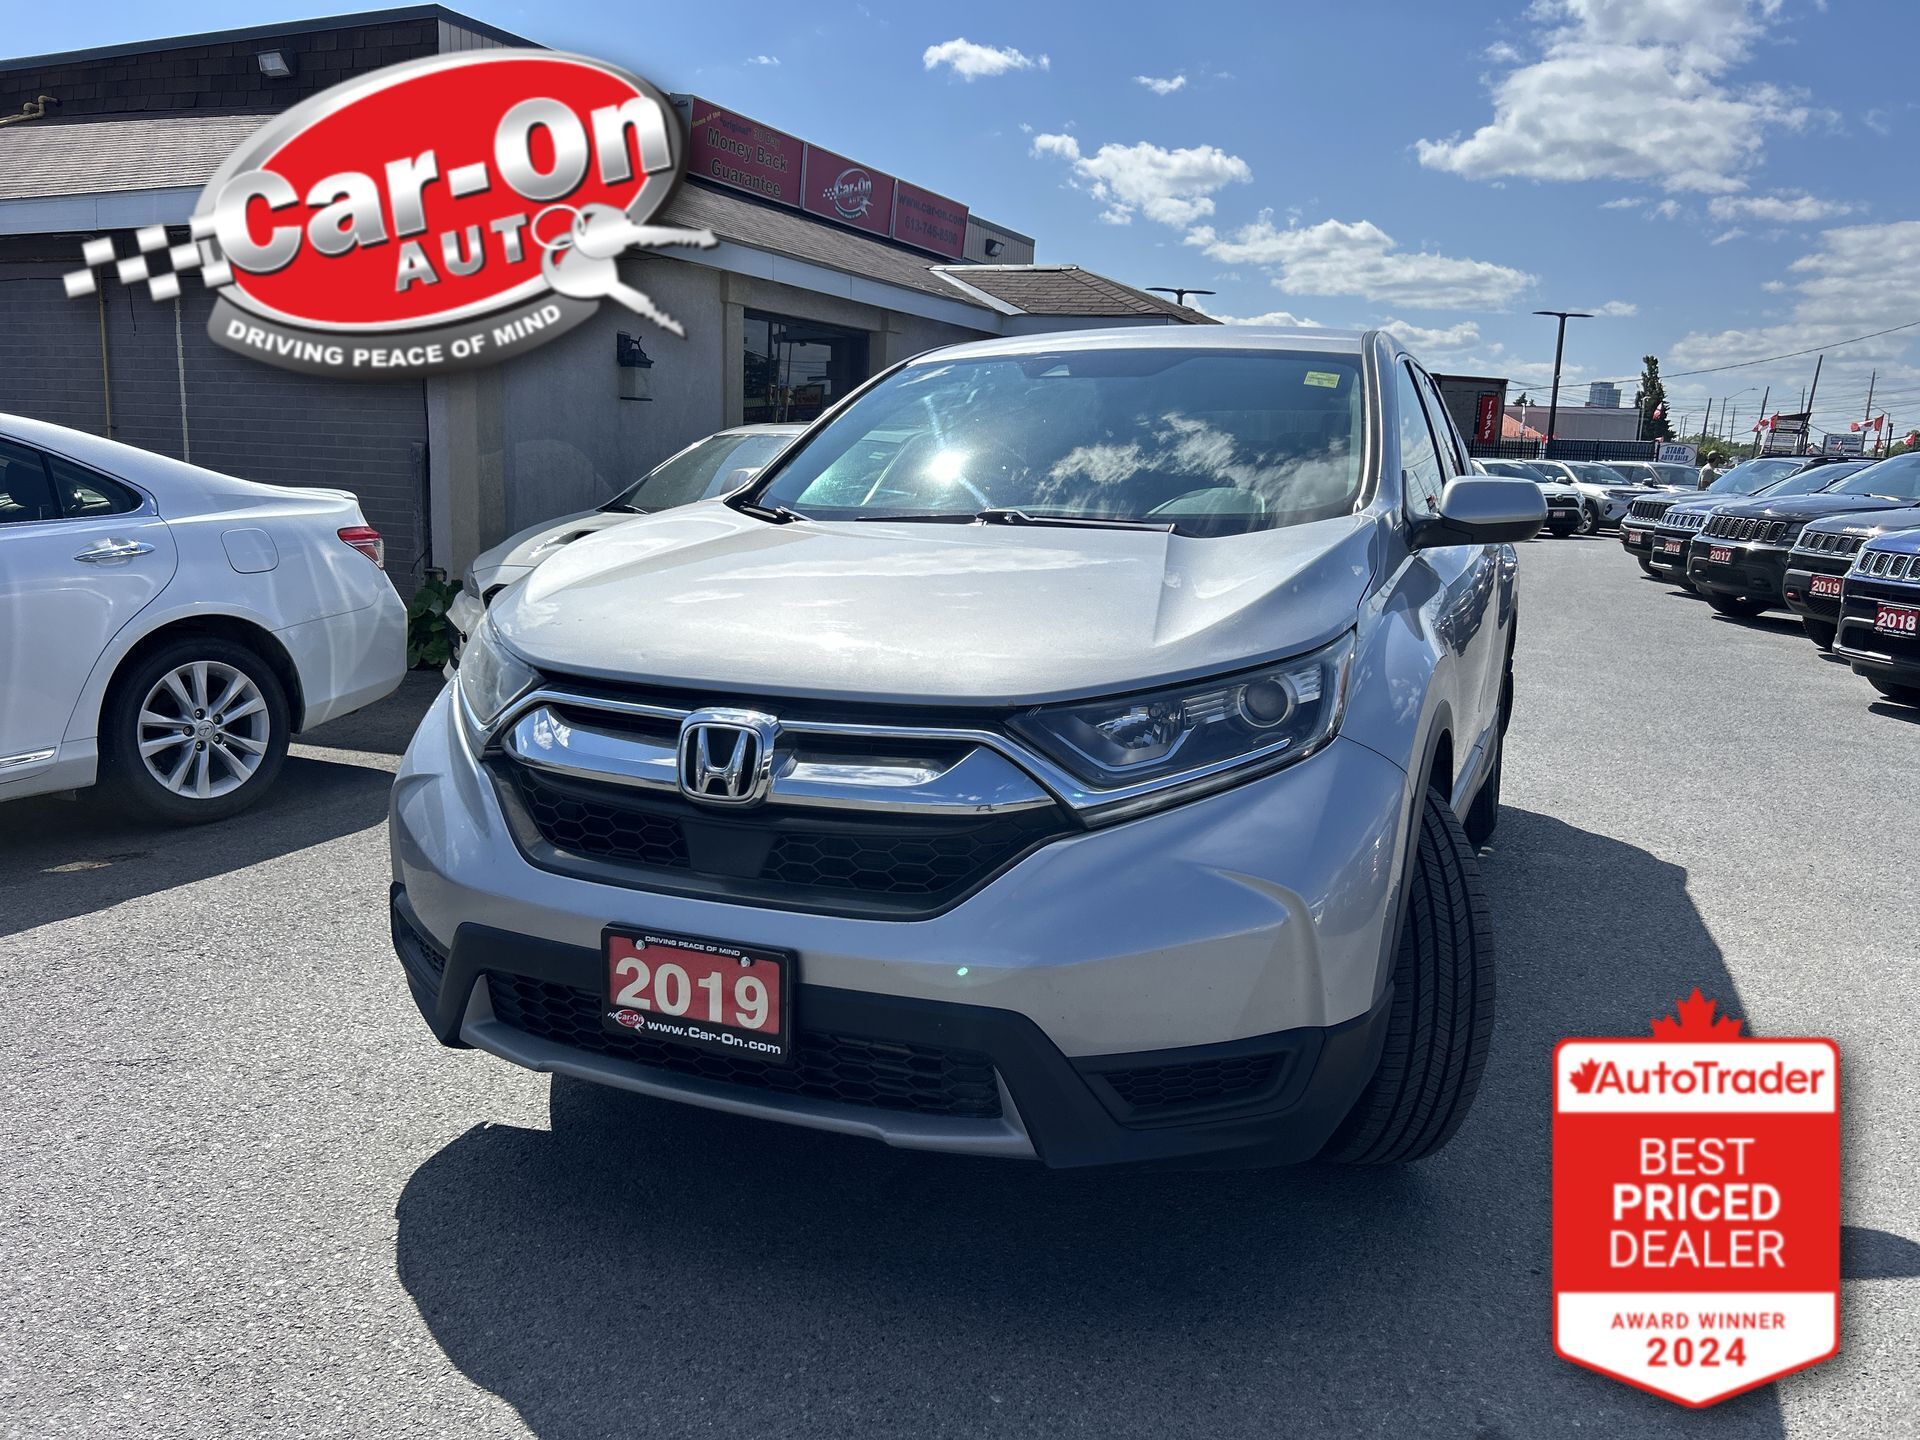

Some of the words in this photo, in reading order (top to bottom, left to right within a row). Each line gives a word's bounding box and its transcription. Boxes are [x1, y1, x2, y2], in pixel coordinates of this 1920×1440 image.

[706, 127, 753, 163] Money
[756, 144, 788, 173] Back
[711, 157, 782, 197] Guarantee
[834, 177, 872, 196] Car-On
[1665, 446, 1687, 455] STARS
[1664, 543, 1680, 552] 2018
[1710, 550, 1732, 562] 2017
[1811, 580, 1840, 594] 2019
[1877, 612, 1916, 631] 2018
[645, 935, 677, 946] DRIVING
[678, 941, 705, 952] PEACE
[718, 948, 741, 957] MIND
[615, 956, 769, 1030] 2019
[647, 1021, 781, 1054] www.Car-On.com
